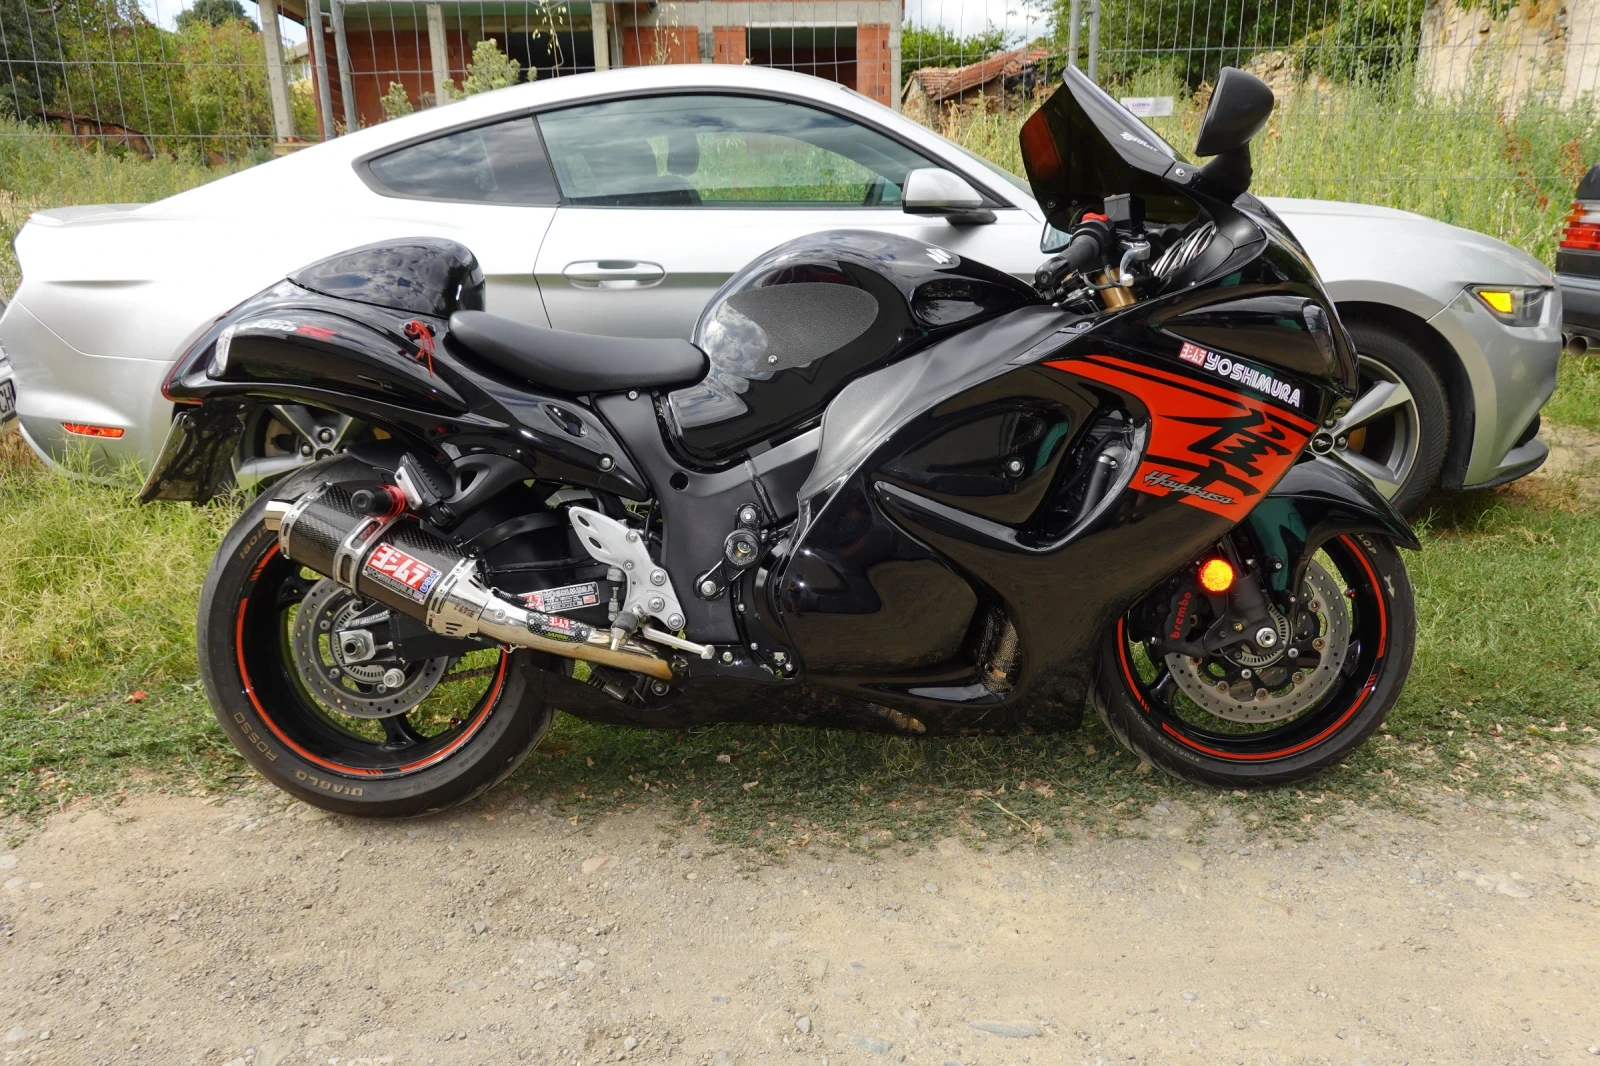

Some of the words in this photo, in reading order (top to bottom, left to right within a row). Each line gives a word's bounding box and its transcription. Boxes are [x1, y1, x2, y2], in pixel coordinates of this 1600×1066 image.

[1180, 343, 1207, 364] ヨシムラ
[1204, 351, 1300, 408] YOSHIMURA
[1143, 470, 1236, 504] Hayabusa
[371, 546, 429, 587] ヨシムラ
[420, 571, 438, 593] USA
[1170, 592, 1192, 639] brembo
[233, 711, 278, 761] ROSSO
[295, 769, 364, 797] DIABLO
